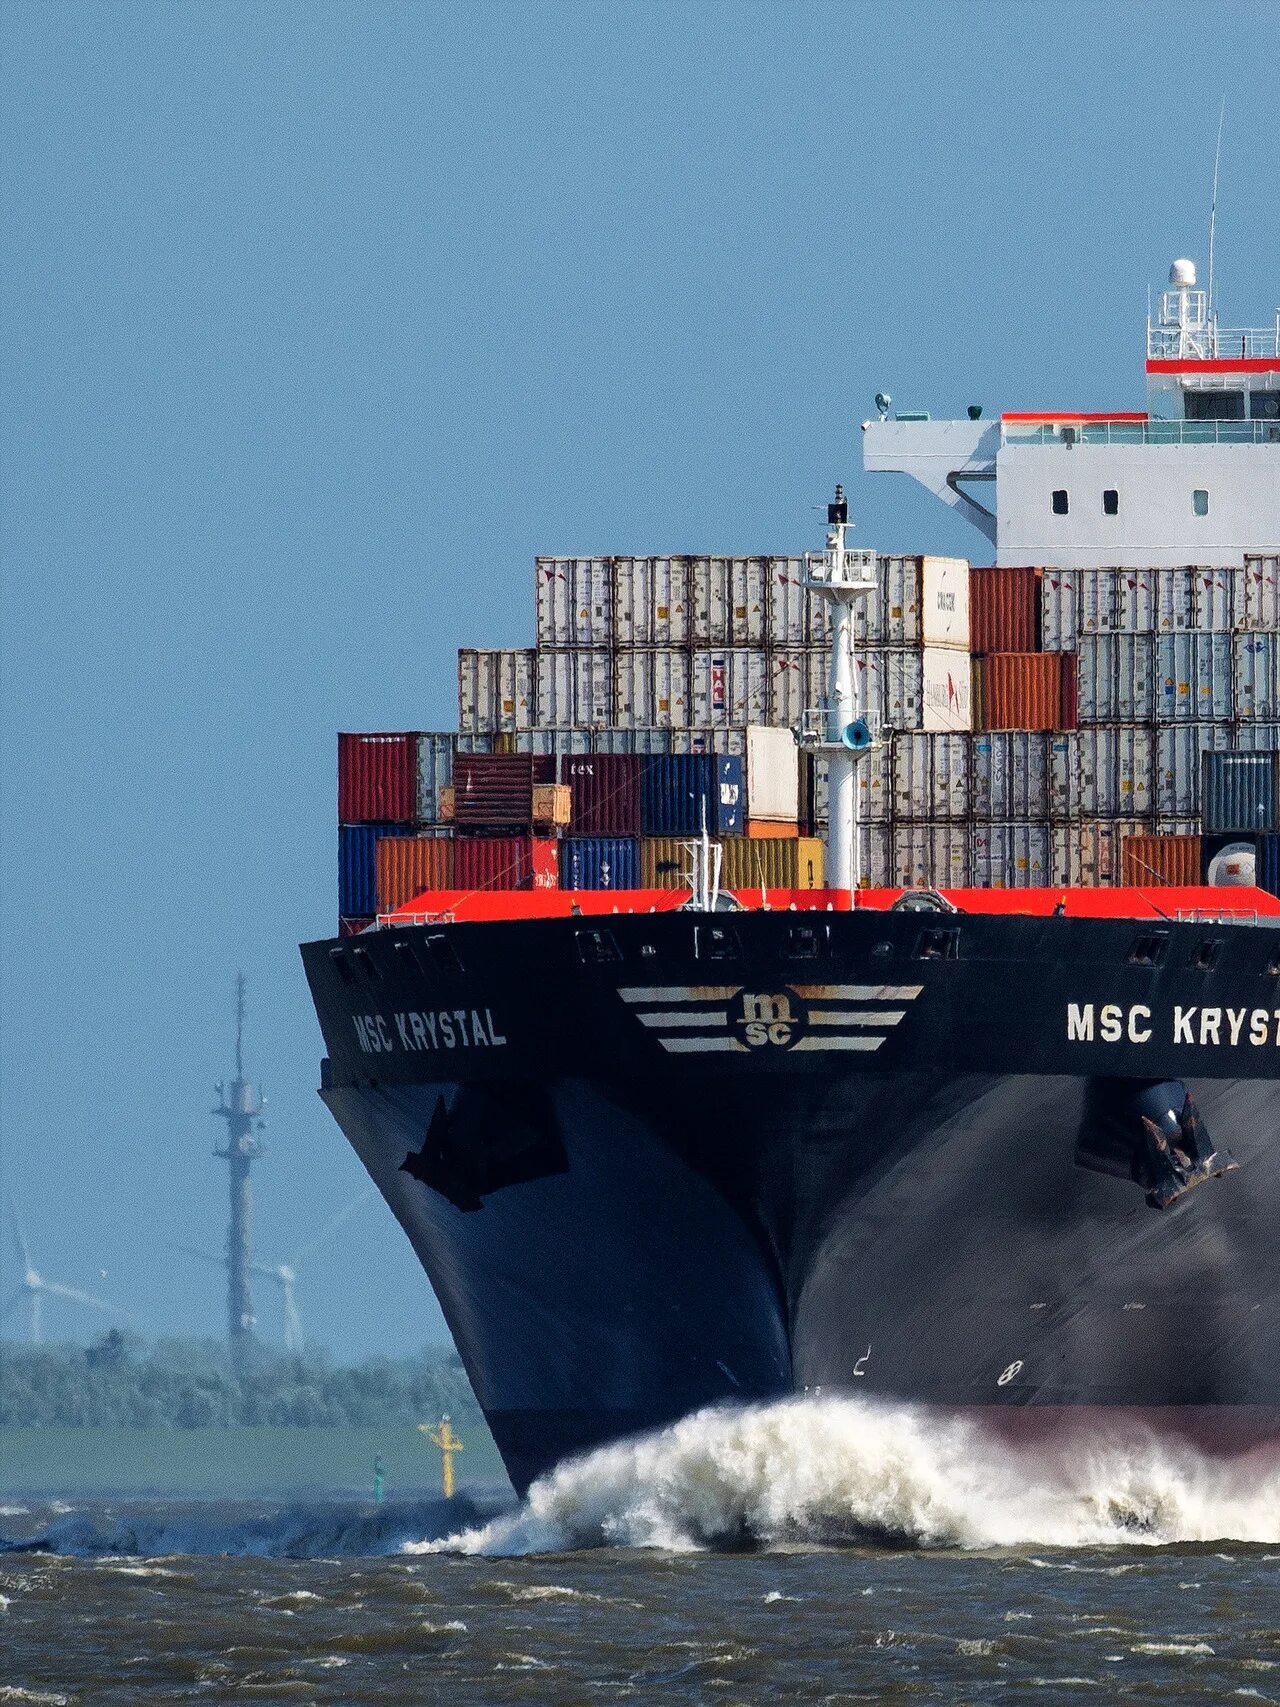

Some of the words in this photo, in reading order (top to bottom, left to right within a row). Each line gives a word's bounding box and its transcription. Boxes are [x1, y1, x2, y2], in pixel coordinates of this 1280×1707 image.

[712, 667, 725, 702] TAL
[352, 1014, 393, 1053] MSC
[394, 1008, 507, 1051] KRYSTAL
[1067, 1003, 1153, 1044] MSC
